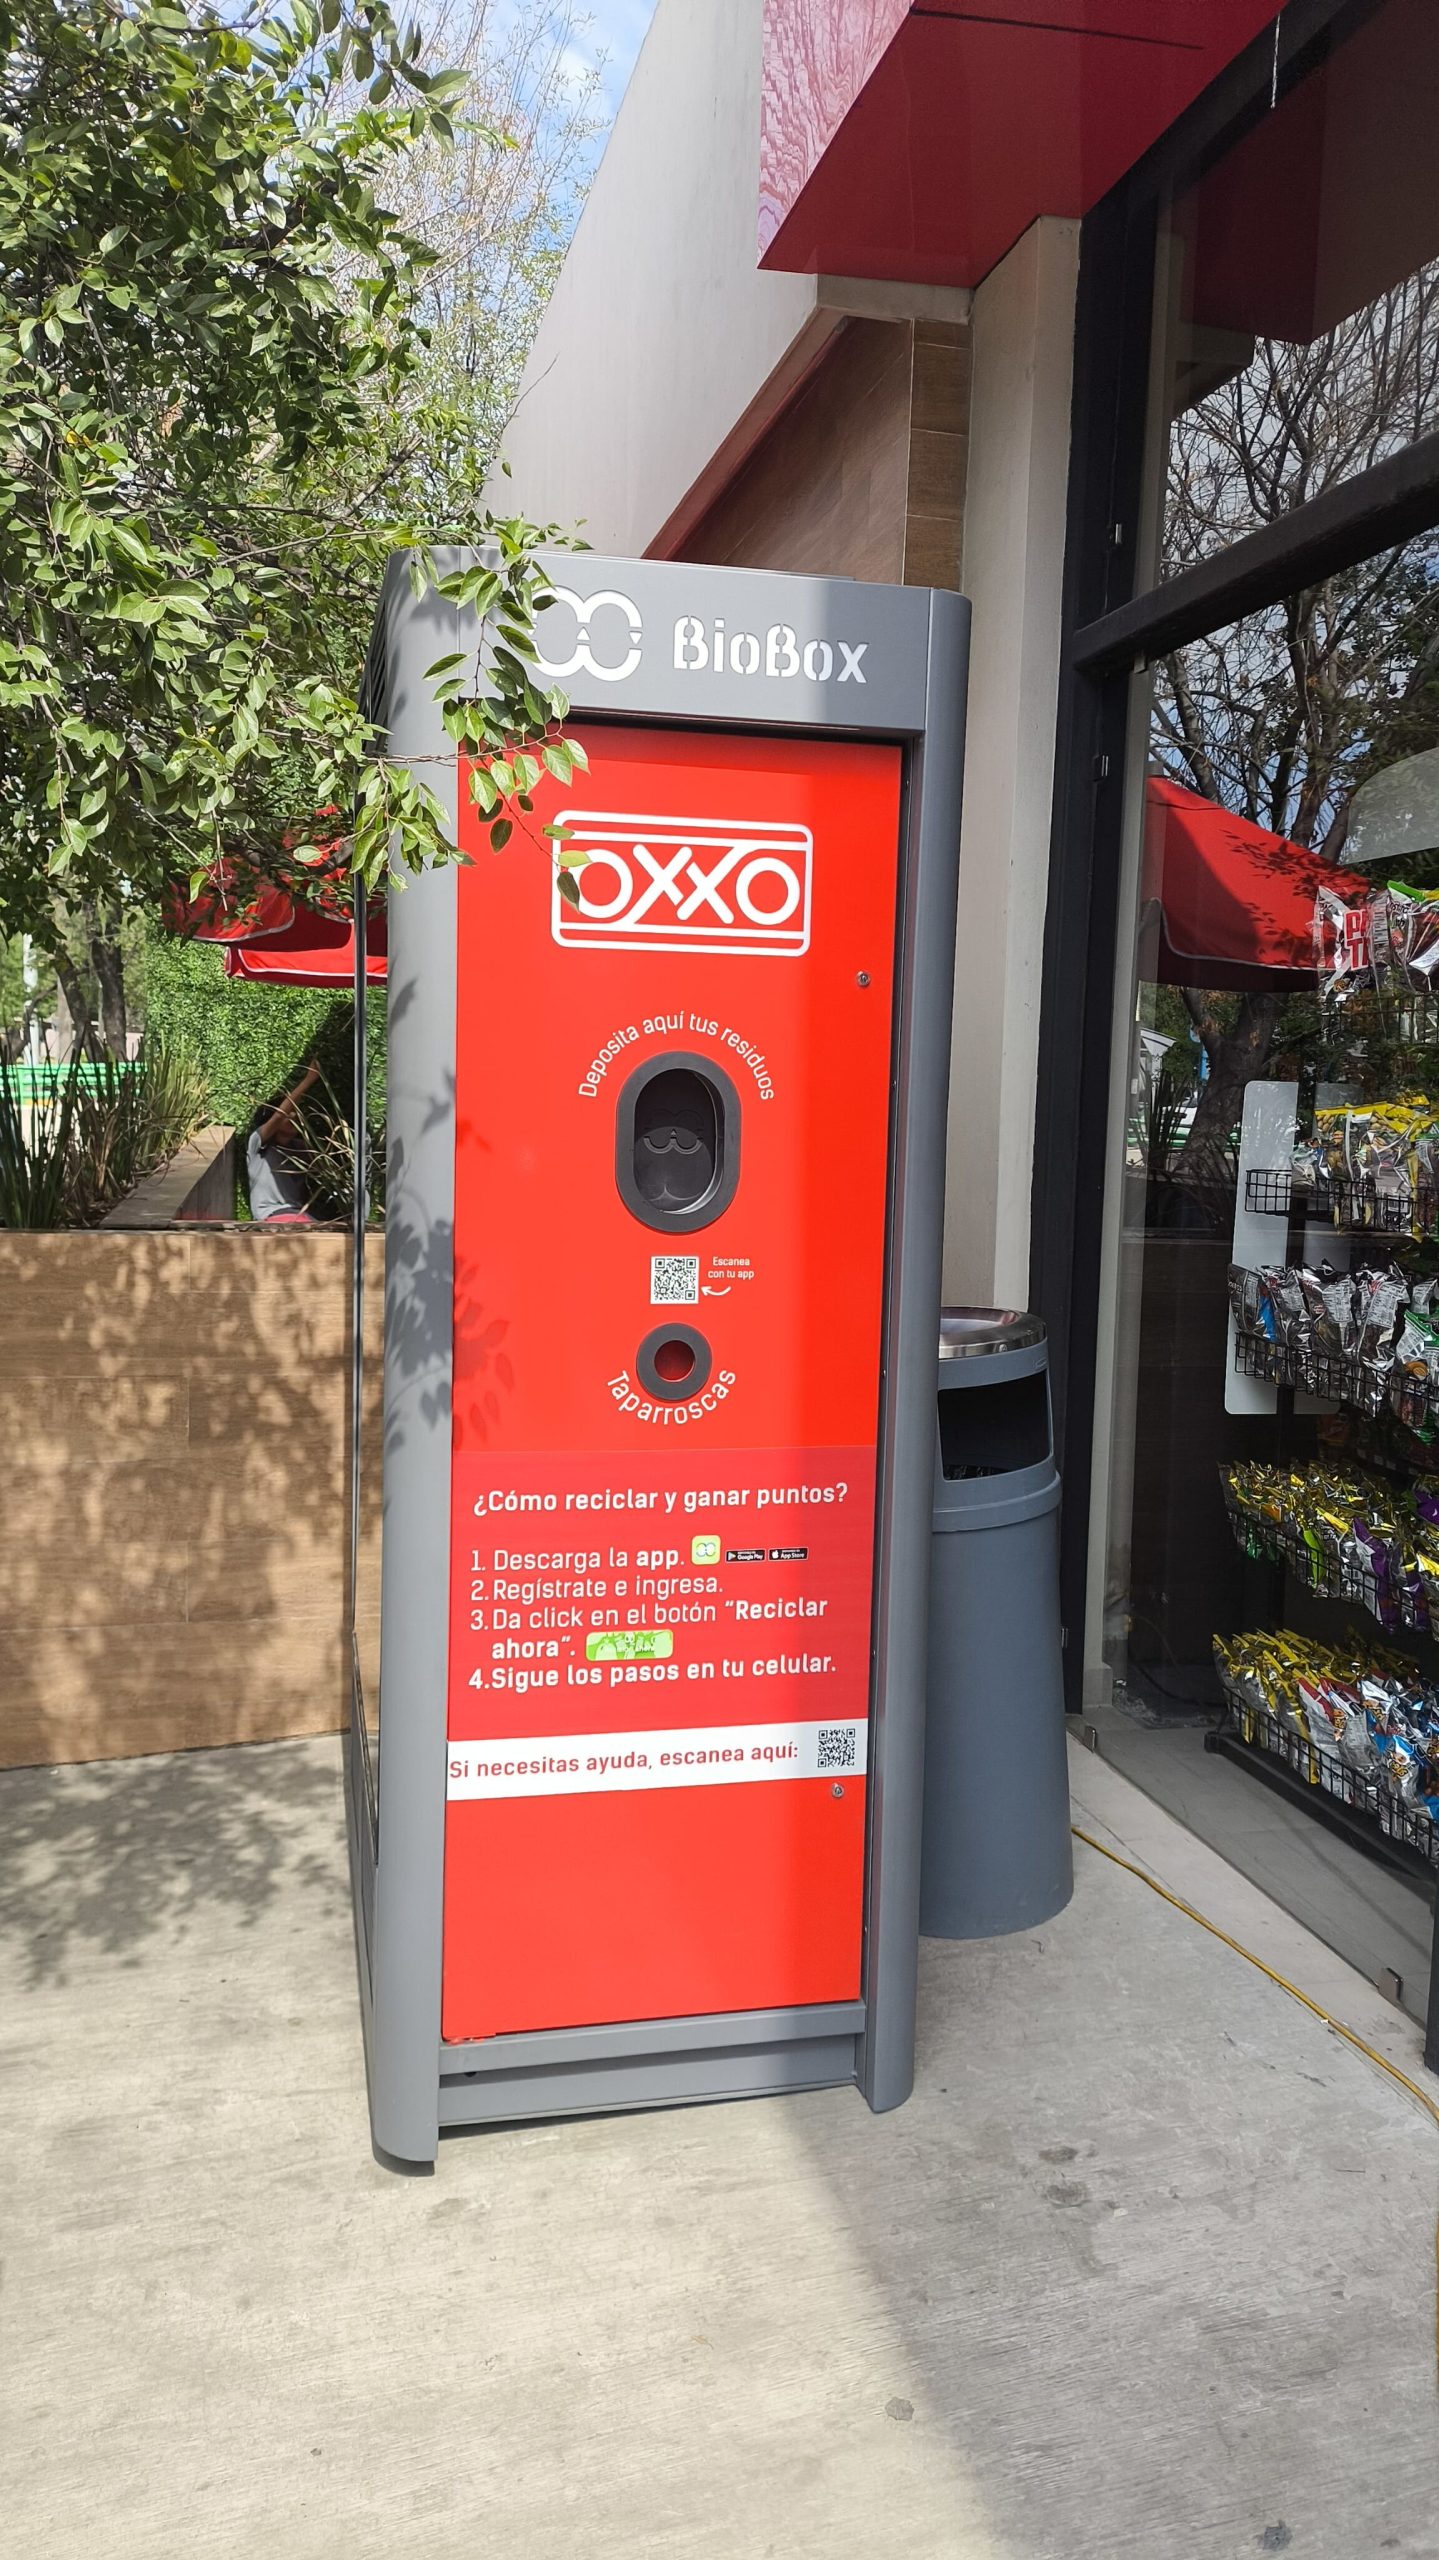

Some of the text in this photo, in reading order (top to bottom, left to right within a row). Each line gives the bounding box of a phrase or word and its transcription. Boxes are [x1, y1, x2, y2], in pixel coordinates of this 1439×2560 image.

[673, 615, 869, 683] BioBox
[568, 844, 801, 926] OXXO
[579, 1011, 774, 1100] Deposita aquí tus residuos
[707, 1269, 755, 1281] con tu app
[712, 1256, 750, 1266] Escanea
[607, 1370, 736, 1425] Taparroscas
[473, 1482, 849, 1517] ¿Cómo reciclar y ganar puntos?
[470, 1547, 685, 1575] 1. Descarga la app.
[780, 1552, 791, 1560] App
[614, 1580, 628, 1597] e
[635, 1575, 723, 1601] ingresa.
[529, 1606, 583, 1629] click
[590, 1609, 619, 1626] en
[627, 1603, 647, 1625] el
[654, 1601, 717, 1624] botón
[567, 1664, 603, 1685] los
[610, 1664, 680, 1688] pasos
[686, 1663, 715, 1680] en
[722, 1659, 744, 1678] tu
[752, 1654, 836, 1676] celular.
[449, 1741, 799, 1779] Si necesitas ayuda, escanea aquí:
